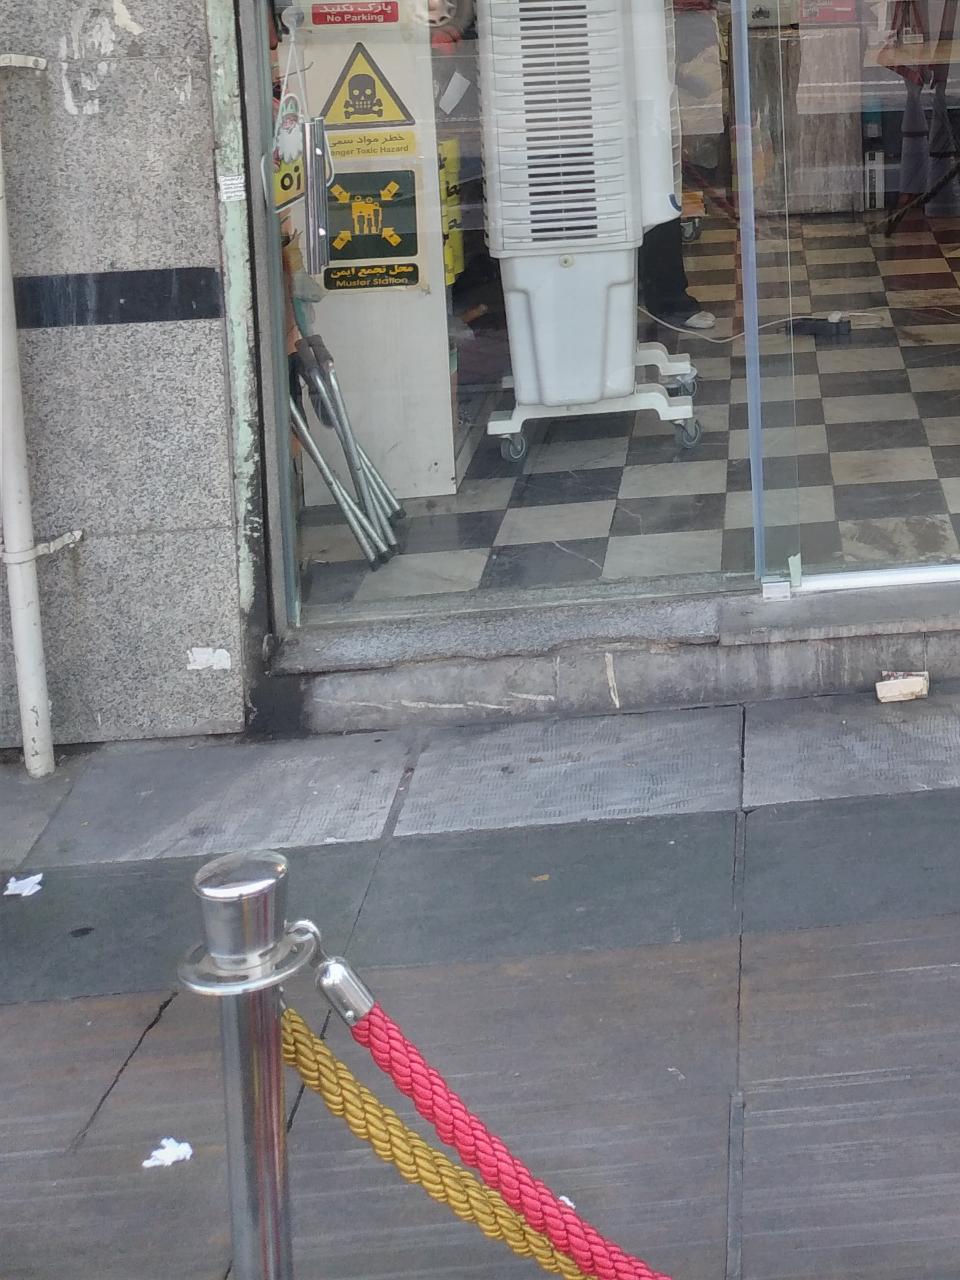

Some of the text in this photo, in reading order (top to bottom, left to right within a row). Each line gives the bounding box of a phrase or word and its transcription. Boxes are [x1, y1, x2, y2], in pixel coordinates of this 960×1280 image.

[326, 13, 384, 23] No Parking
[356, 135, 379, 146] مواد
[381, 133, 406, 144] خطر
[330, 149, 354, 157] anger
[380, 145, 409, 153] Hazard
[330, 264, 414, 279] محل تجمع ایمن
